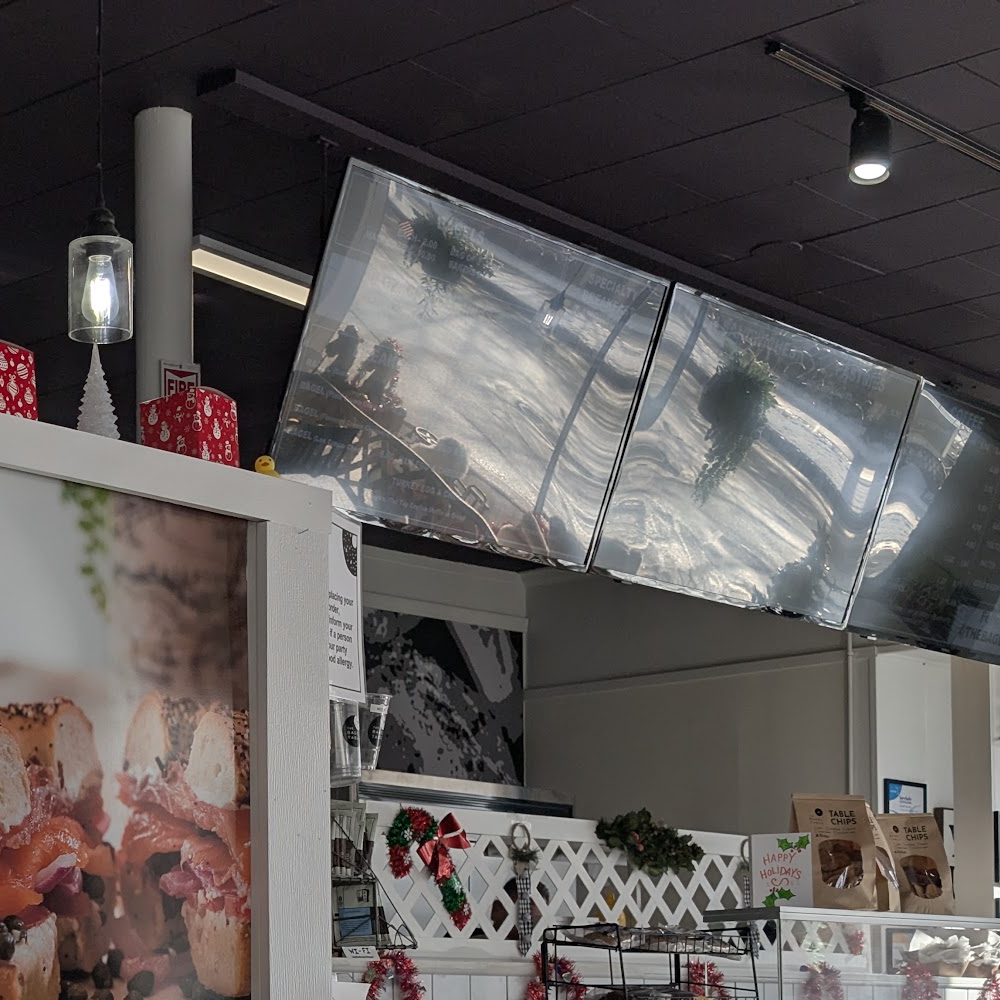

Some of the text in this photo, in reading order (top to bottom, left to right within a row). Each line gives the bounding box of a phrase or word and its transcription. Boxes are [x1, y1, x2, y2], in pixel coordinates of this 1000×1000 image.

[337, 632, 353, 643] person
[336, 645, 348, 656] party
[828, 809, 856, 818] TABLE
[830, 817, 857, 826] CHIPS
[903, 825, 927, 834] TABLE
[905, 833, 929, 841] CHIPS
[763, 852, 797, 866] HAPPY
[759, 866, 802, 880] HOLIDAYS
